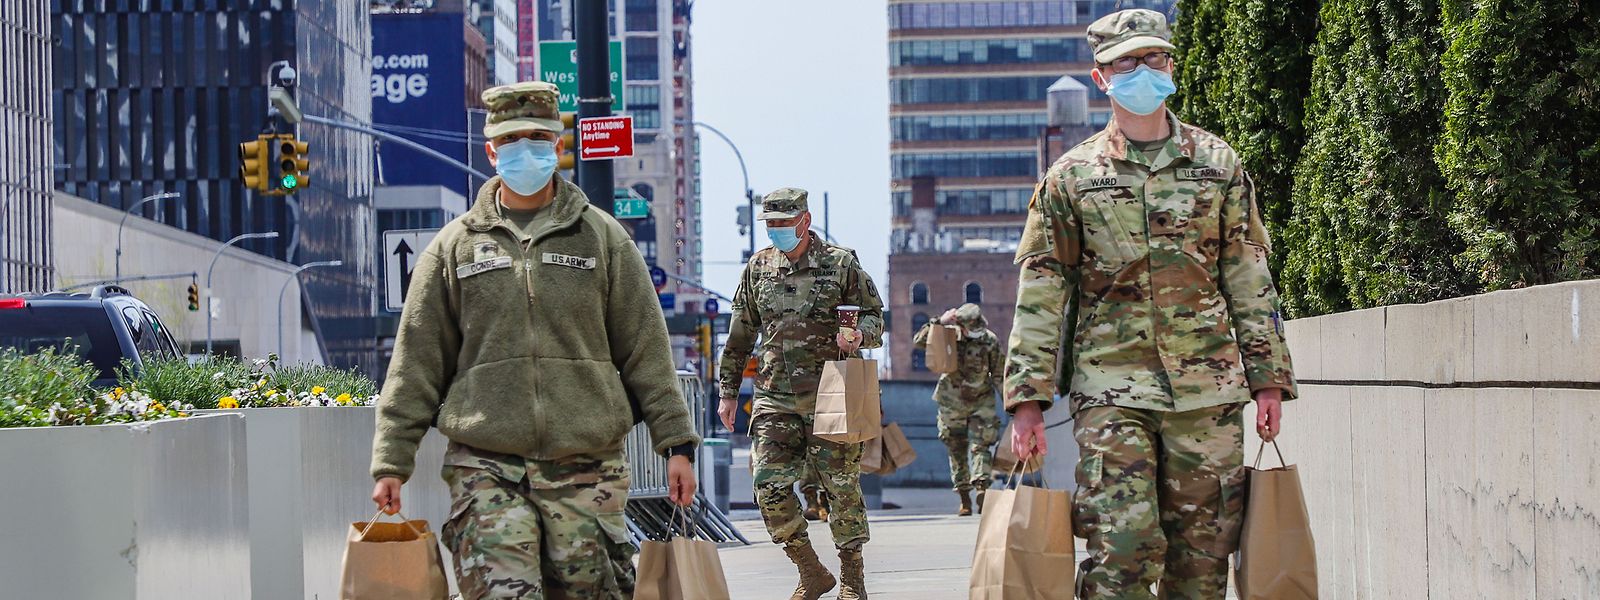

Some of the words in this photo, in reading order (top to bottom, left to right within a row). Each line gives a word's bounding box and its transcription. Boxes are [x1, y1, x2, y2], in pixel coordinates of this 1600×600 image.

[544, 71, 578, 83] Wes
[582, 122, 592, 131] NO
[592, 120, 625, 131] STANDING
[583, 131, 610, 142] Anytime
[1200, 168, 1221, 178] ARMY
[1090, 177, 1117, 187] WARD
[615, 201, 631, 215] 34
[565, 256, 587, 268] ARMY
